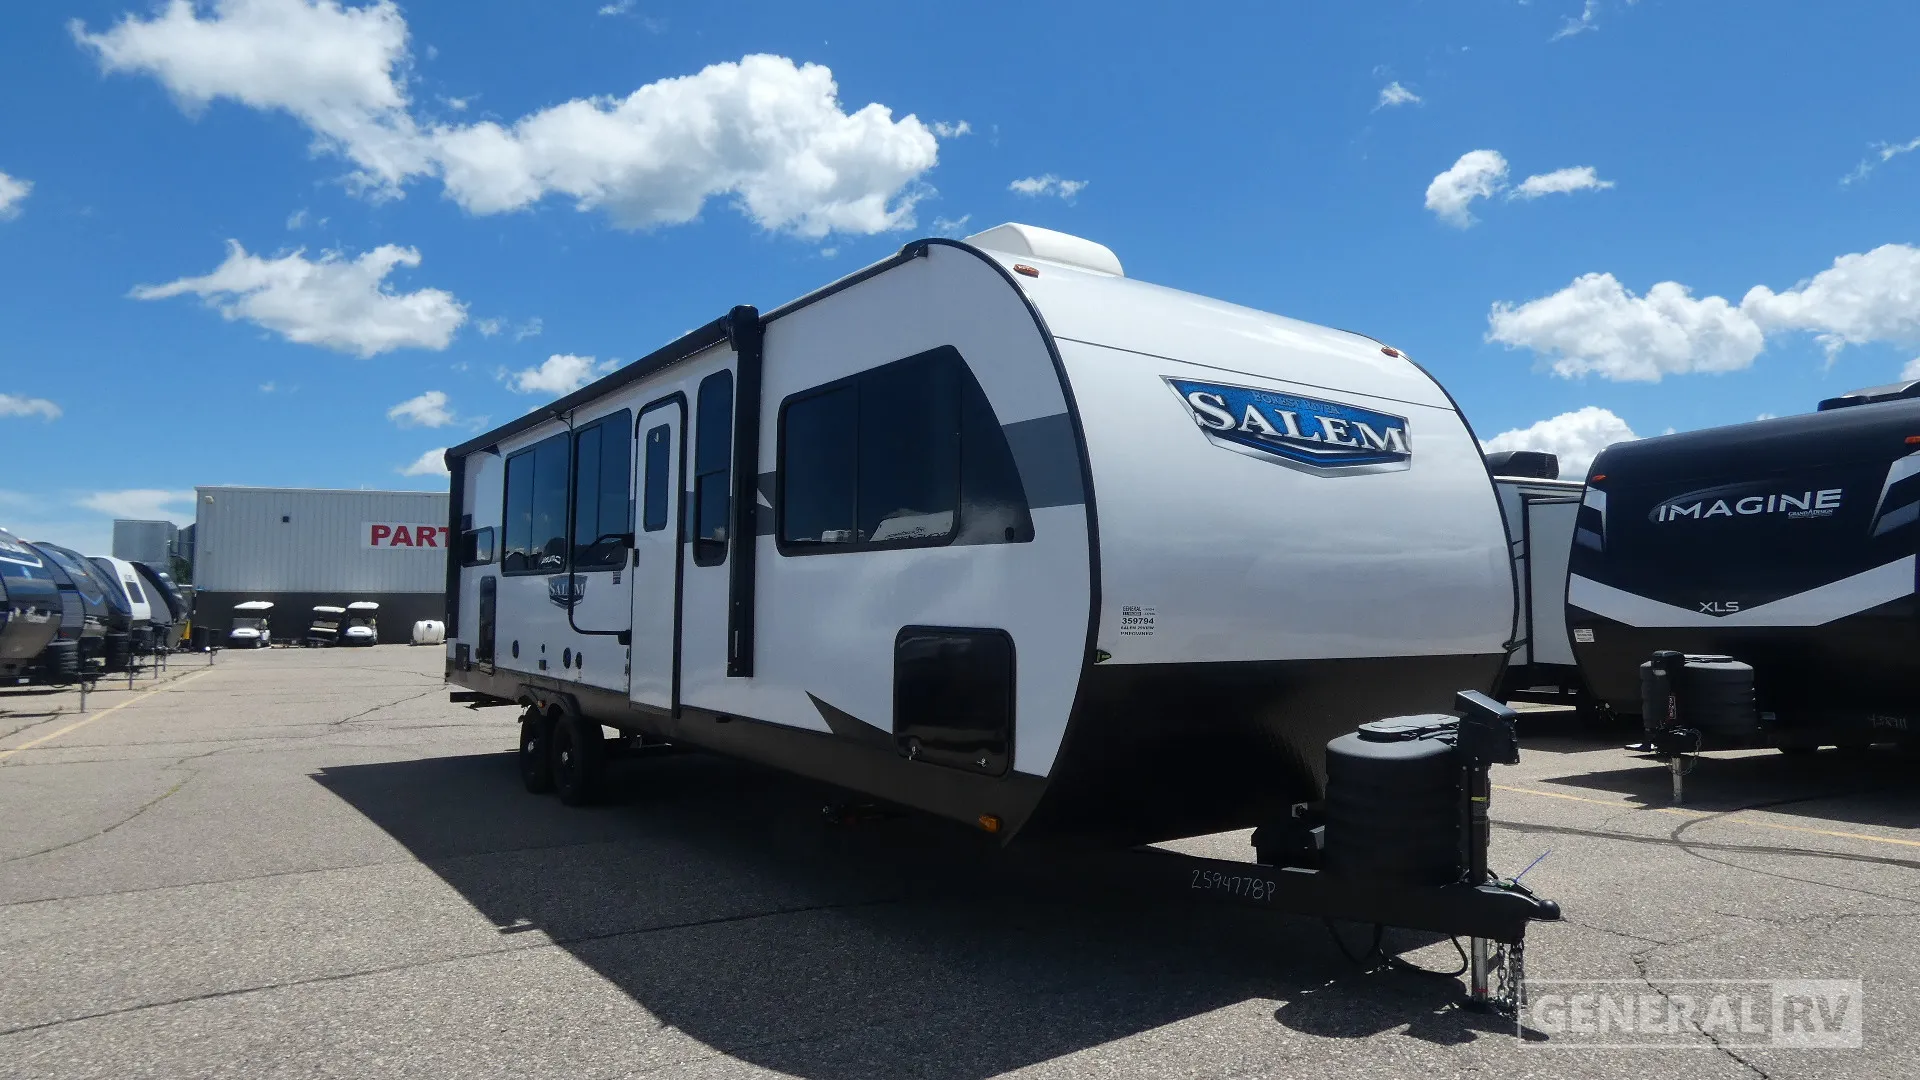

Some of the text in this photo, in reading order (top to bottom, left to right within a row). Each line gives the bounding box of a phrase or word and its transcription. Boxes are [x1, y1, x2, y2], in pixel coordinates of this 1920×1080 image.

[1251, 390, 1341, 415] FOREST RIVER
[1187, 391, 1406, 454] SALEM
[1658, 488, 1843, 522] IMAGINE
[548, 583, 585, 596] SALM
[1698, 600, 1740, 613] XLS
[1121, 617, 1154, 625] 359794
[1191, 869, 1276, 902] 2594778P
